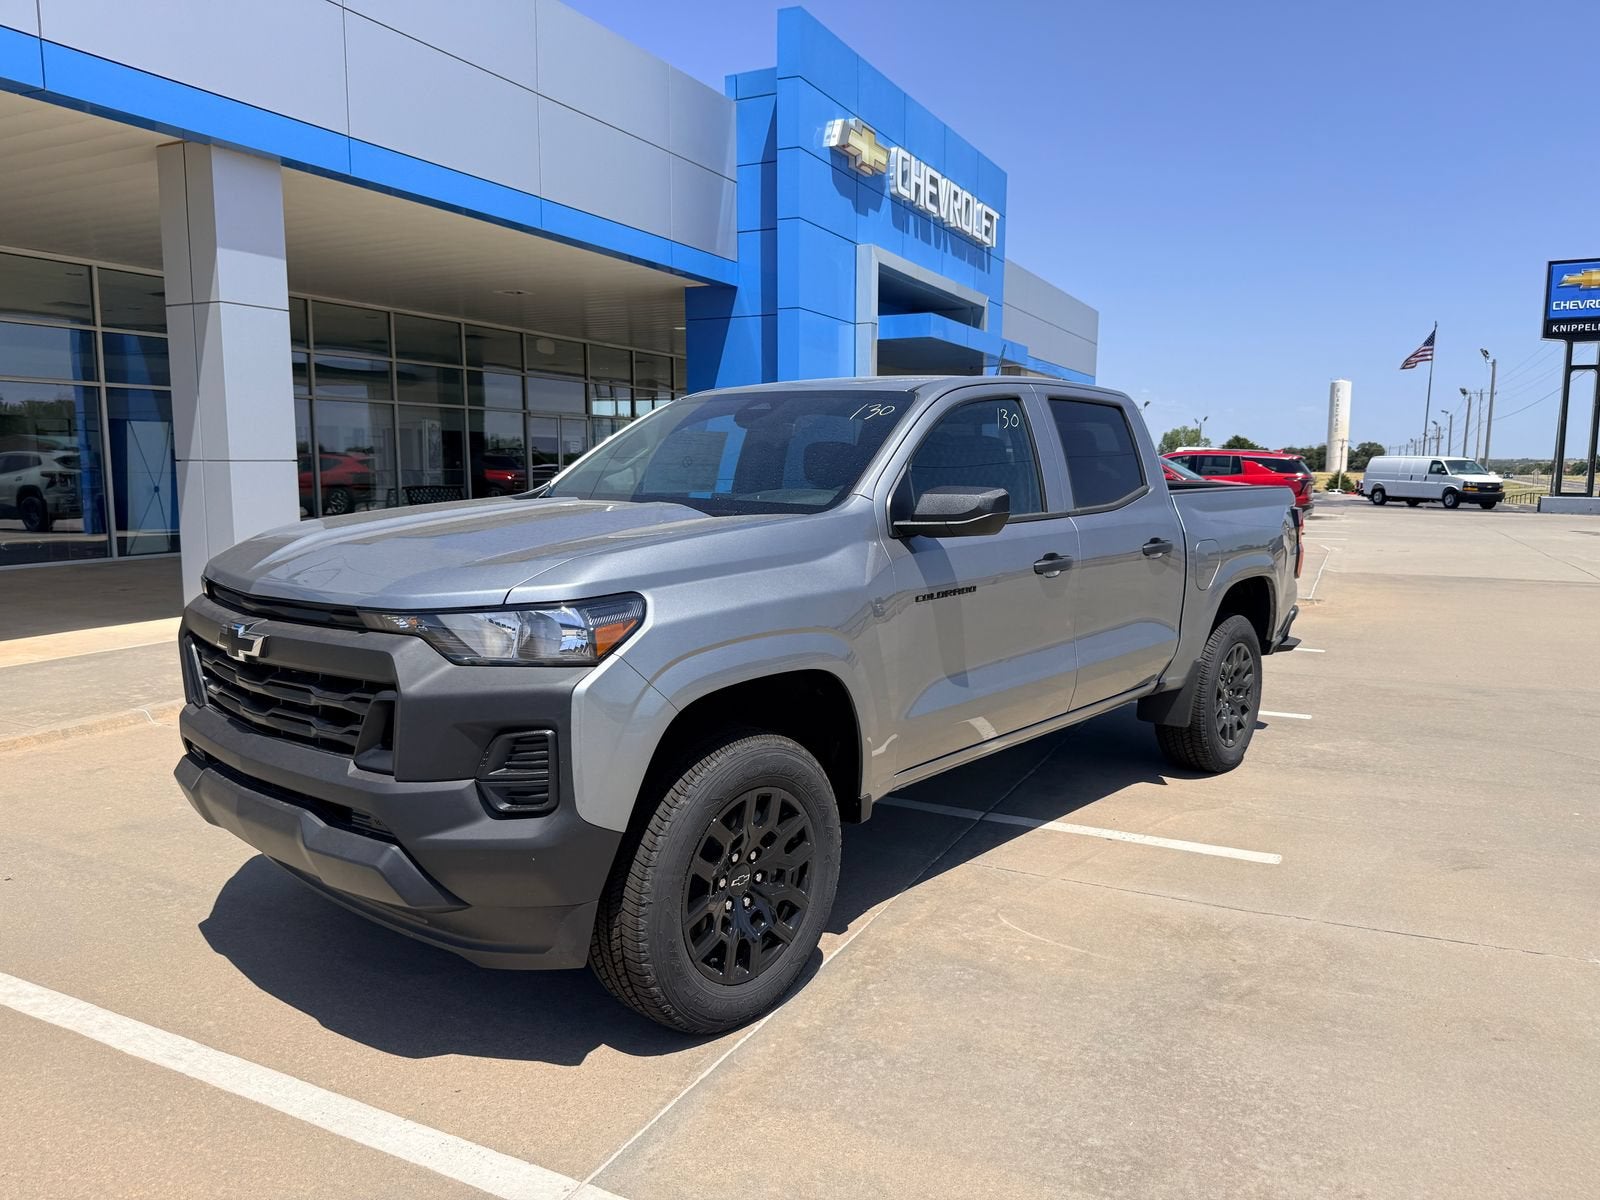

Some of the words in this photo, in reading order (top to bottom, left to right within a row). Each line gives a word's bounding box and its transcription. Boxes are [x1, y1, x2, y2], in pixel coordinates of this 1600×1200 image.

[889, 147, 999, 248] CHEVROLET
[1552, 323, 1600, 333] KNIPPEL
[849, 403, 896, 420] 130
[997, 407, 1020, 430] 130
[914, 586, 977, 603] COLORADO
